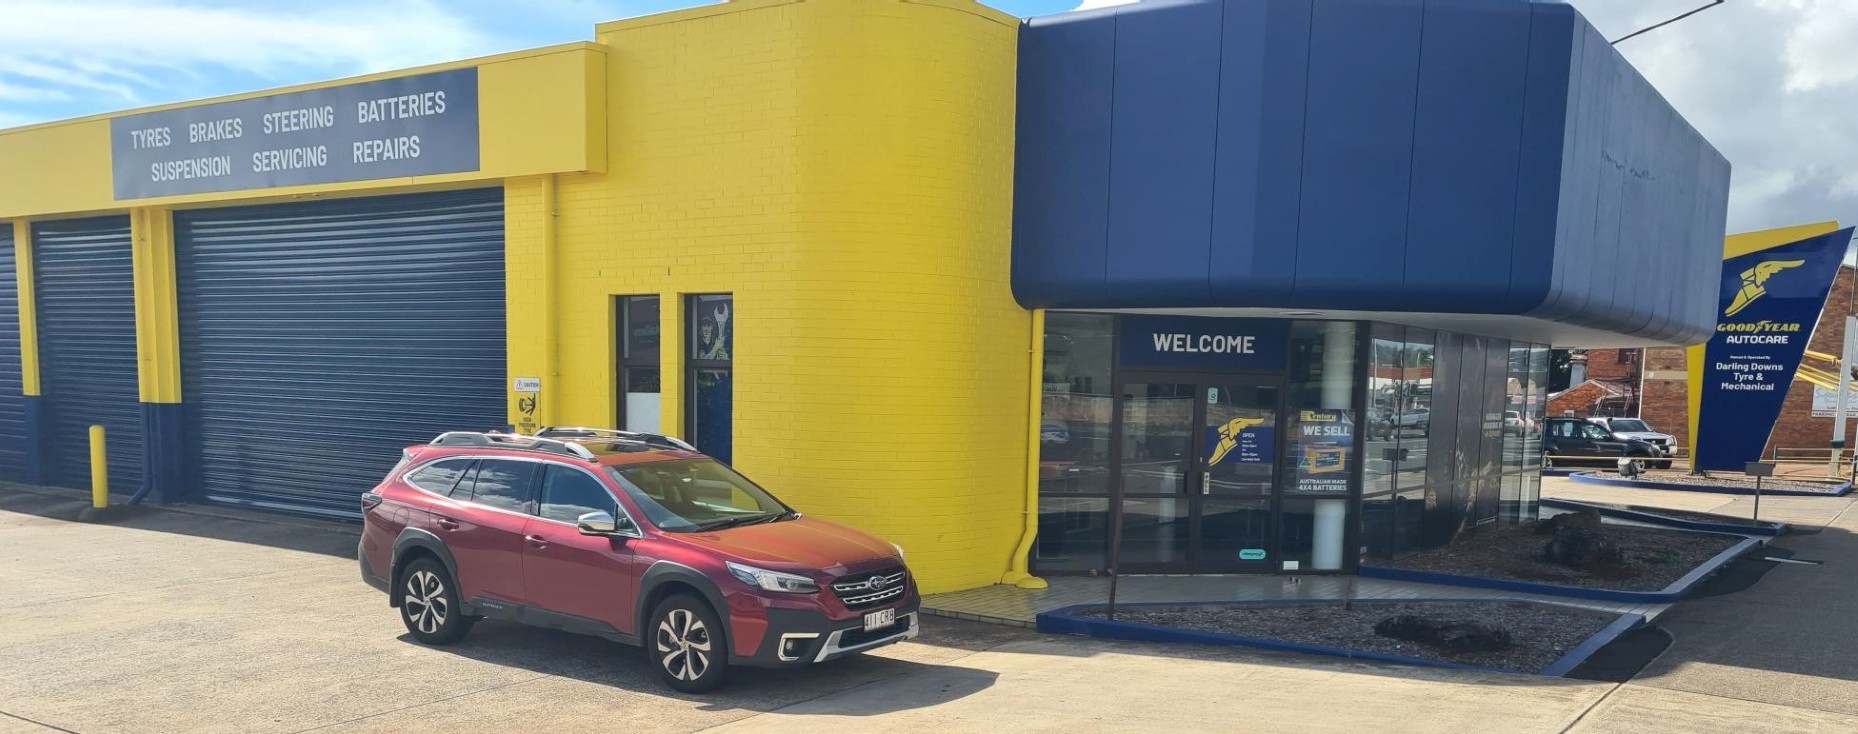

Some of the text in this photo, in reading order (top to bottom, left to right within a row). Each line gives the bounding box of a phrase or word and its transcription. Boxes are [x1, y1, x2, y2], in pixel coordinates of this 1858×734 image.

[131, 90, 446, 149] TYRES BRAKES STEERING BATTERIES
[151, 135, 421, 182] SUSPENSION SERVICING REPAIRS
[1153, 333, 1256, 353] WELCOME
[1726, 335, 1789, 344] AUTOCARE
[1716, 362, 1784, 372] Darling Downs
[1733, 372, 1764, 382] Tyre &
[1721, 382, 1775, 391] Mechanical
[1303, 425, 1350, 436] WE SELL
